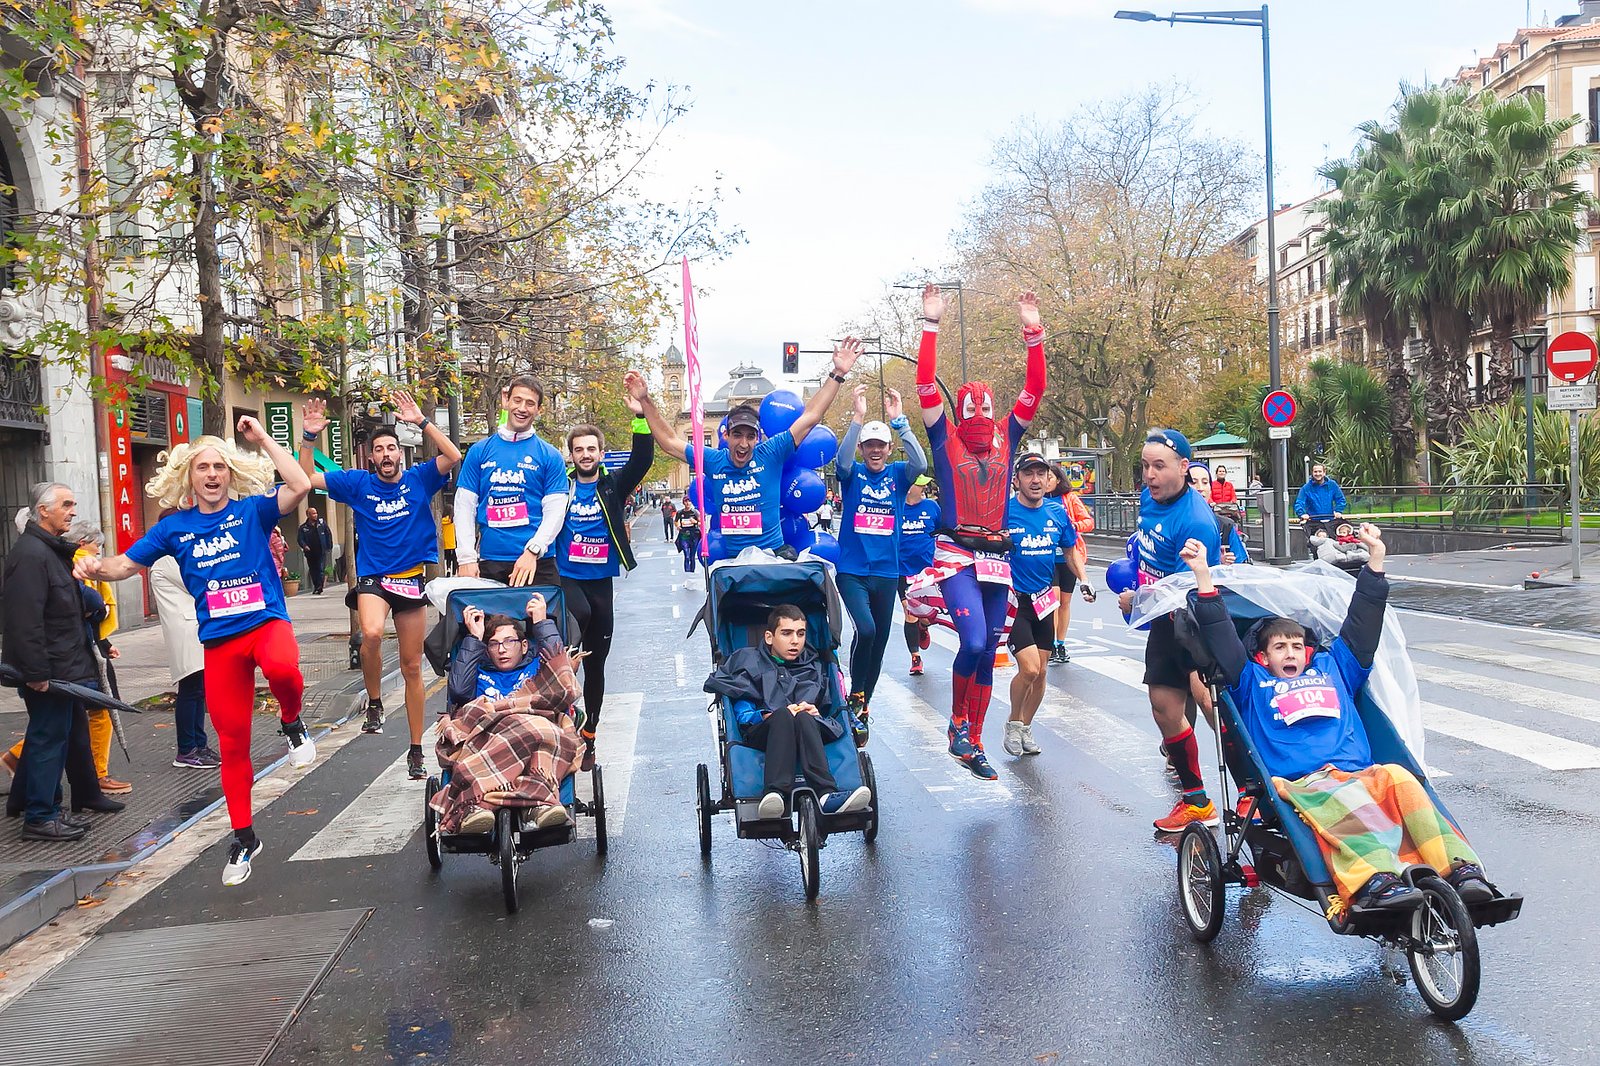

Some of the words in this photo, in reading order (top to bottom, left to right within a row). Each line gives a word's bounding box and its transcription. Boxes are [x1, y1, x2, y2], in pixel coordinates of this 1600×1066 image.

[117, 436, 131, 531] SPAR
[494, 496, 520, 505] ZURICH
[495, 507, 517, 519] 118
[219, 518, 243, 530] ZURICH
[730, 515, 750, 526] 119
[866, 516, 885, 527] 122
[582, 536, 605, 544] ZURICH
[581, 545, 600, 556] 109
[197, 552, 241, 569] #imparables
[986, 561, 1004, 574] 112
[220, 576, 253, 588] ZURICH
[222, 589, 250, 605] 108
[1038, 594, 1051, 609] 114
[1289, 677, 1327, 689] ZURICH
[1294, 690, 1326, 706] 104
